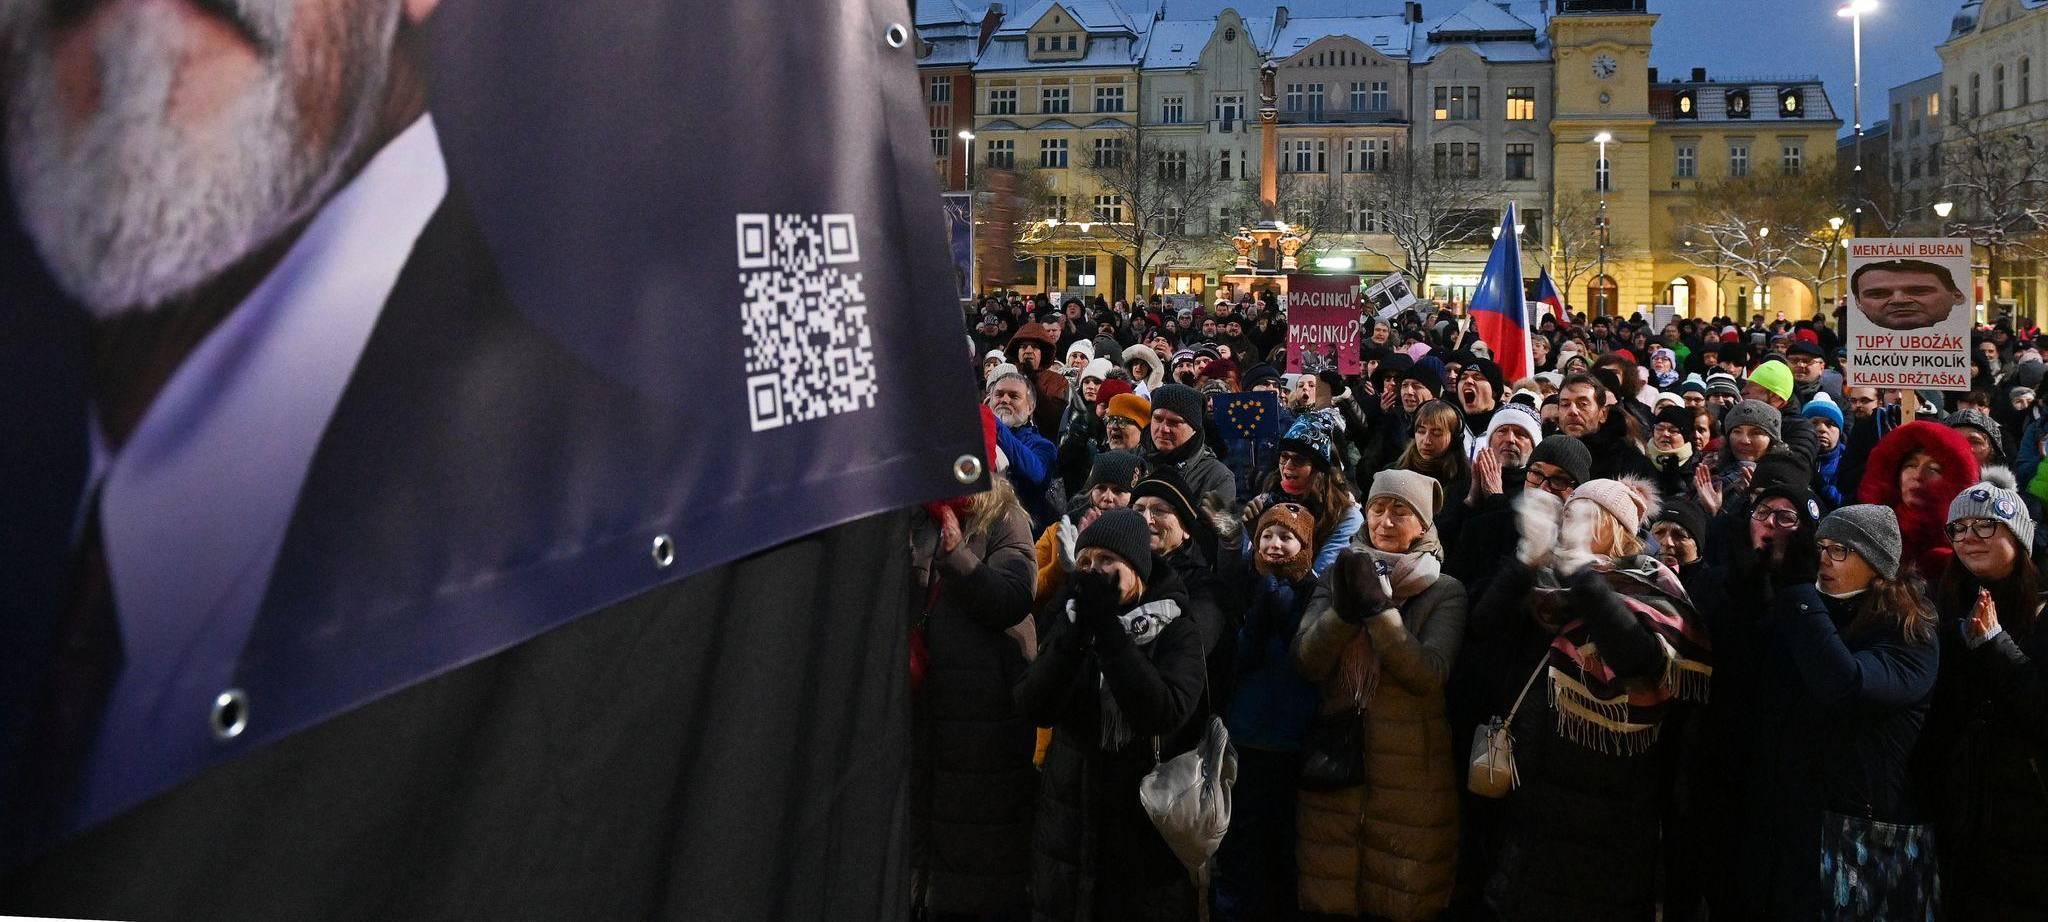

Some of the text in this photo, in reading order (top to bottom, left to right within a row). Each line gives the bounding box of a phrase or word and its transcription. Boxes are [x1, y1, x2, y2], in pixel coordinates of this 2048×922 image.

[1853, 243, 1963, 255] MENTÁLNÍ BURAN
[1289, 285, 1359, 310] MACINKU!
[1289, 320, 1359, 347] MACINKU?
[1856, 333, 1963, 349] TUPÝ UBOŽÁK
[1854, 353, 1966, 368] NÁCKŮV PIKOLÍK
[1854, 371, 1966, 385] KLAUS DRŽTAŠKA
